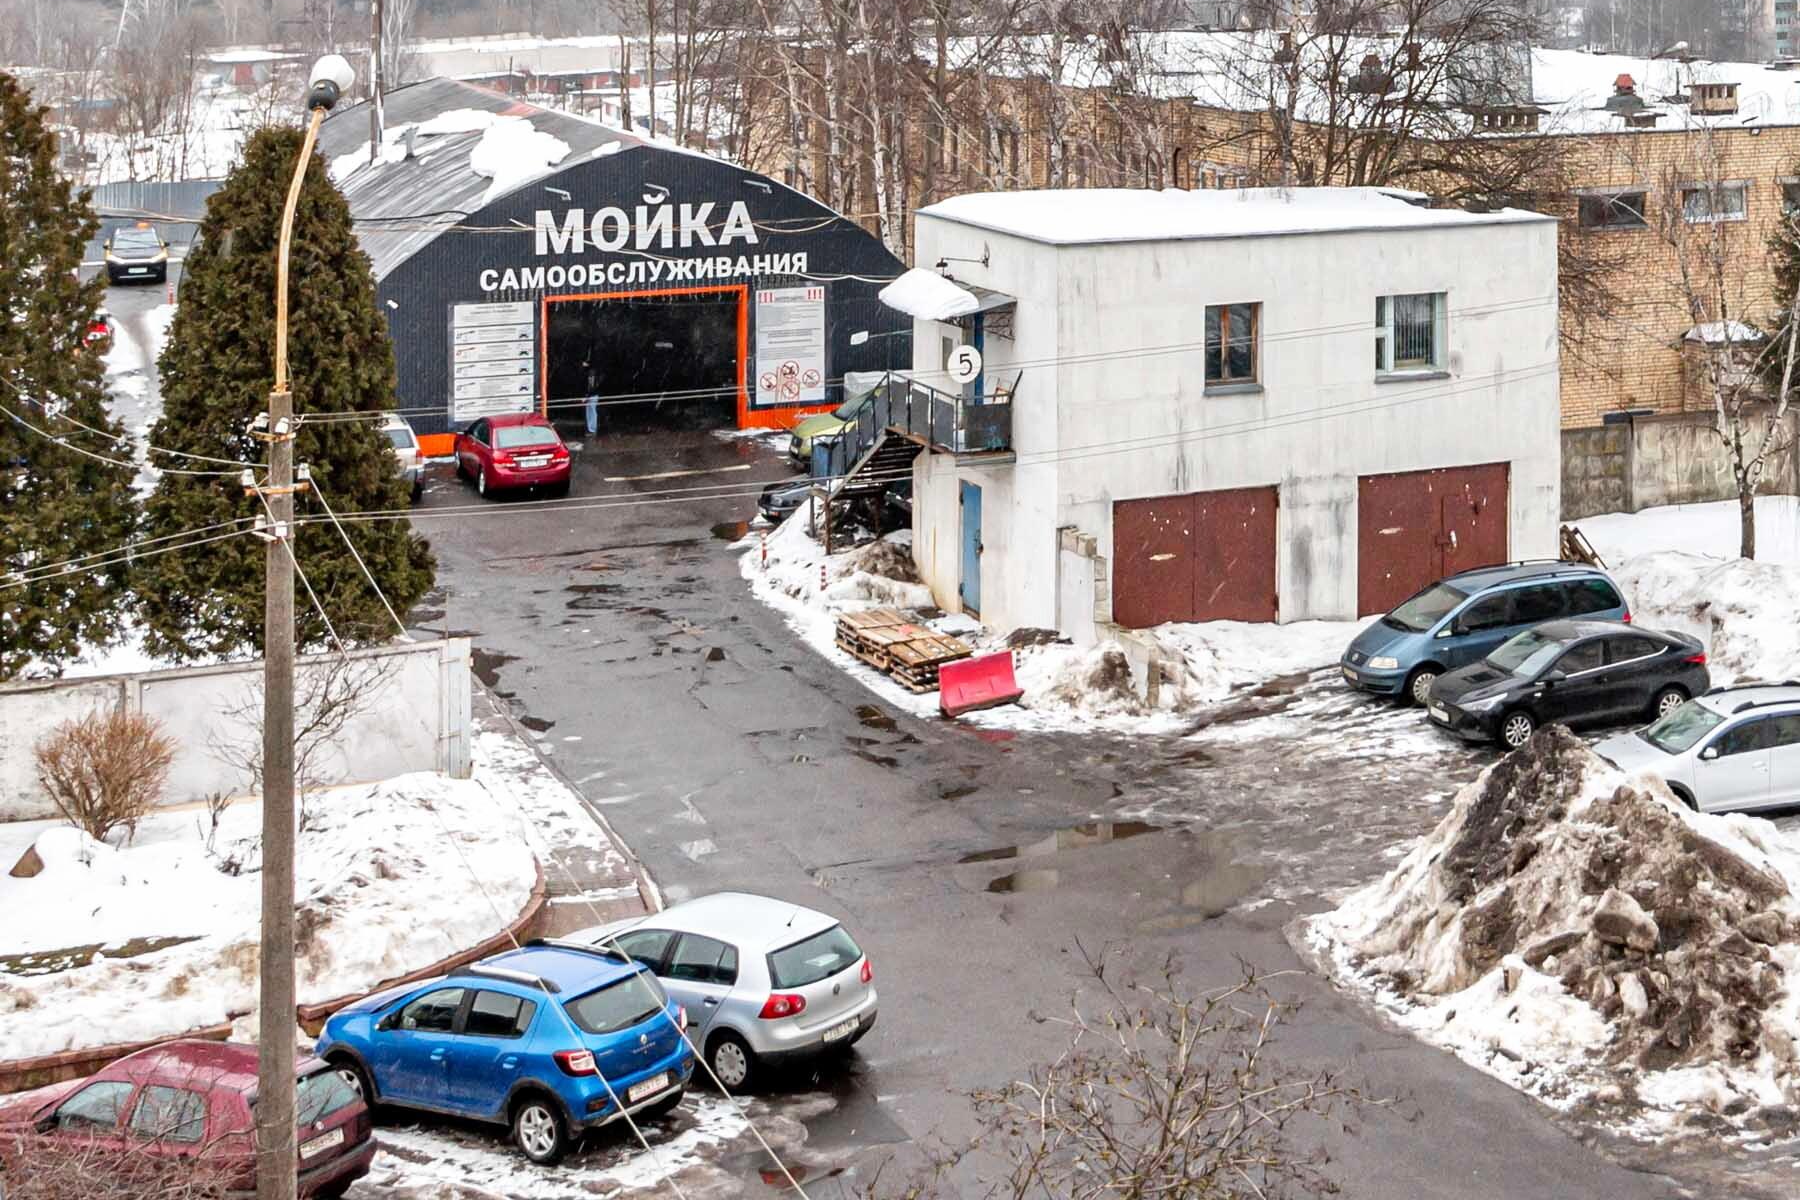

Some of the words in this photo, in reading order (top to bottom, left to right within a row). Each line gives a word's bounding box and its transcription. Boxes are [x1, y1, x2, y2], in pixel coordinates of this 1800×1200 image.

[535, 193, 759, 255] МОЙКА
[479, 251, 807, 291] САМООБСЛУЖИВАНИЯ
[959, 353, 973, 376] 5
